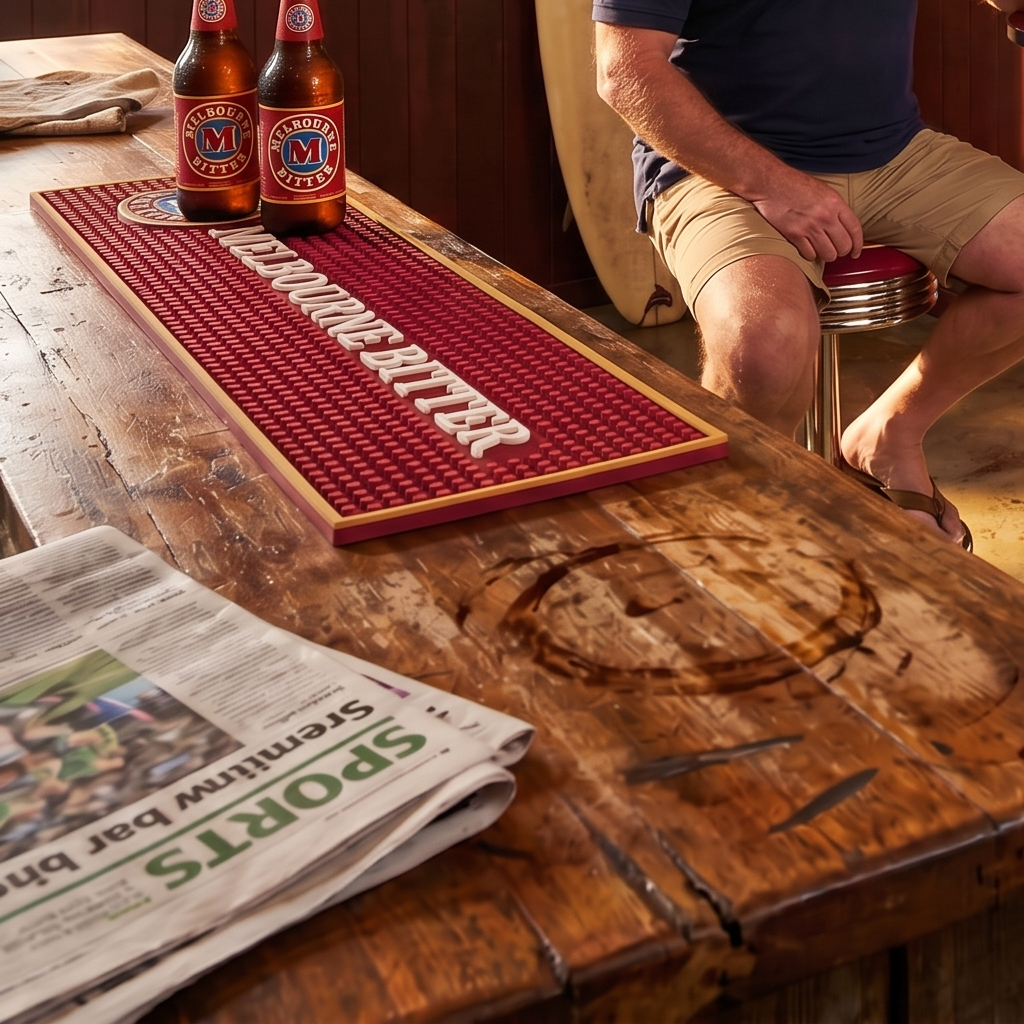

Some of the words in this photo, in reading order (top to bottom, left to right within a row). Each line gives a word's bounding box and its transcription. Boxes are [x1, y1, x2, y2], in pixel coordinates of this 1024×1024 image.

[201, 125, 237, 153] M
[288, 137, 323, 166] M
[208, 225, 404, 351] MELBOURNE
[360, 343, 531, 459] BITTER
[86, 807, 175, 856] bar
[145, 724, 428, 891] SPORTS
